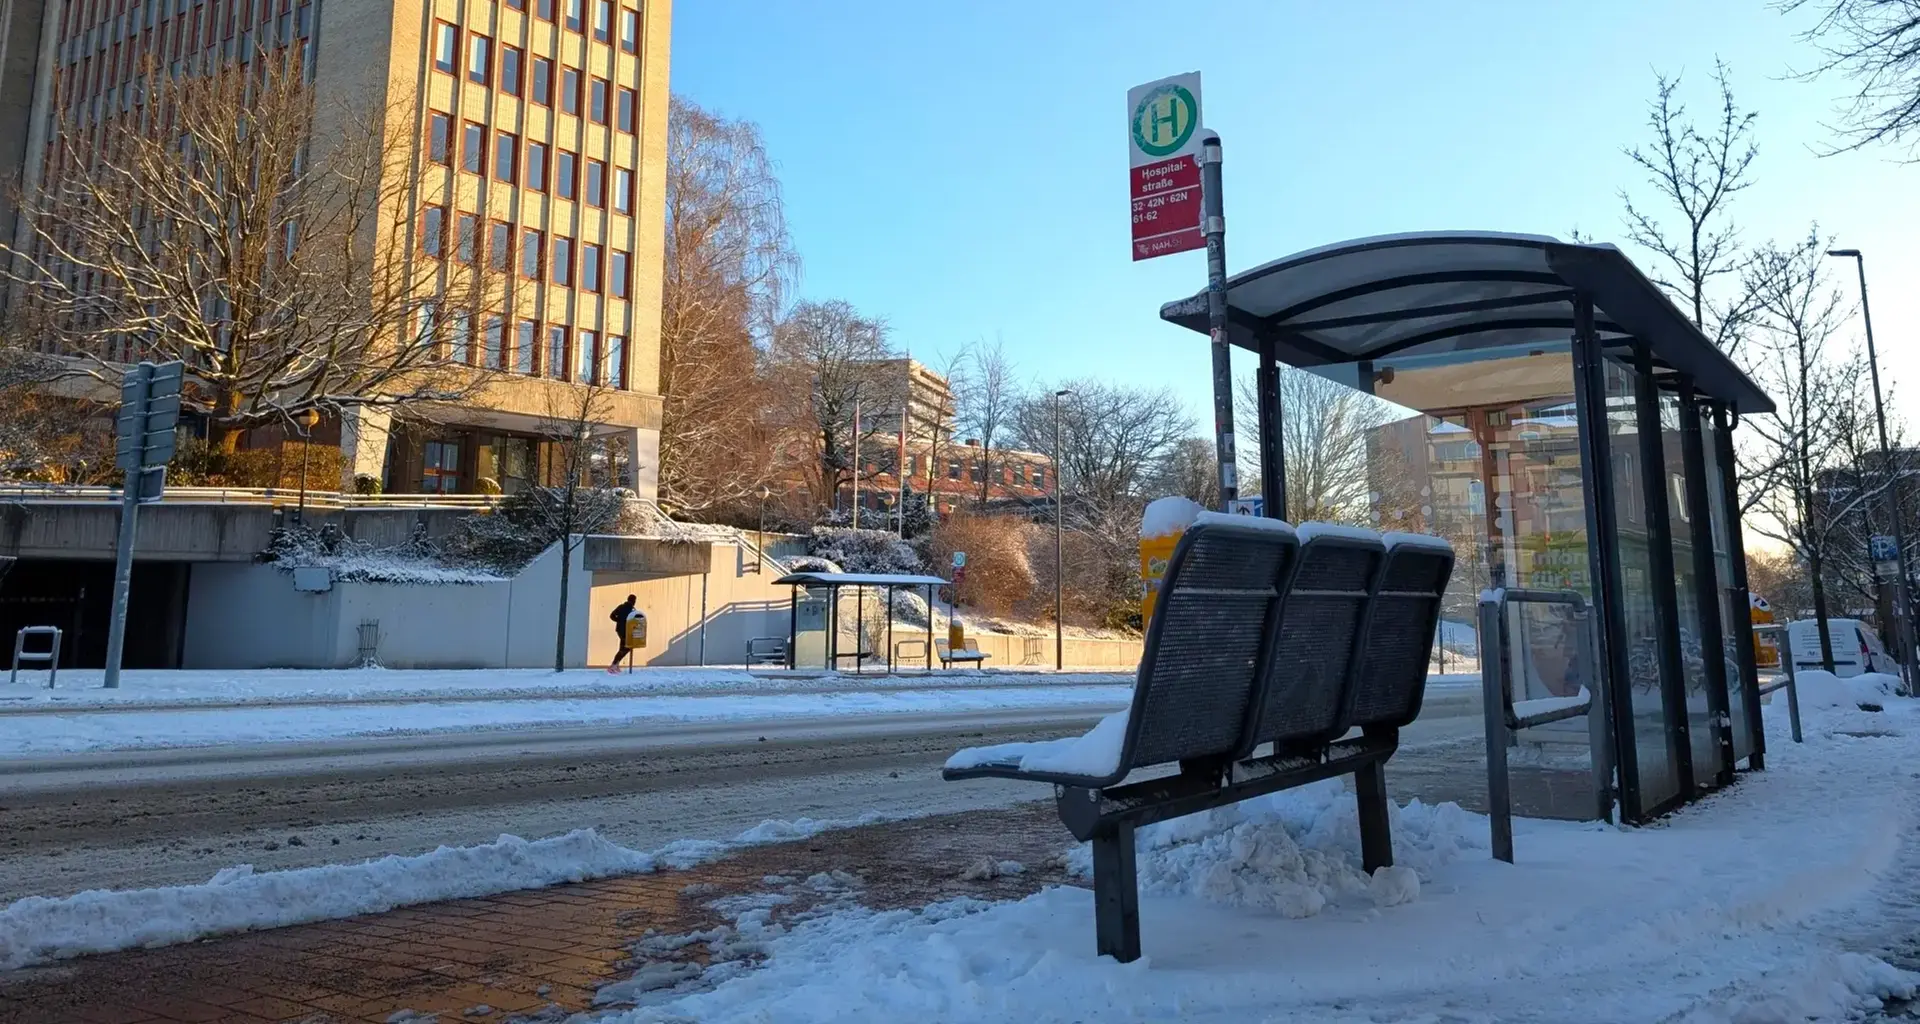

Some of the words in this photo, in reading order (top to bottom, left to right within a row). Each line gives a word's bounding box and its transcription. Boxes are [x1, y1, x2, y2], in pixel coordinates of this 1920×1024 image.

[1151, 98, 1178, 143] H
[1142, 160, 1187, 180] Hospital-
[1142, 178, 1174, 192] straße
[1147, 196, 1165, 208] 42N
[1170, 191, 1188, 203] 62N
